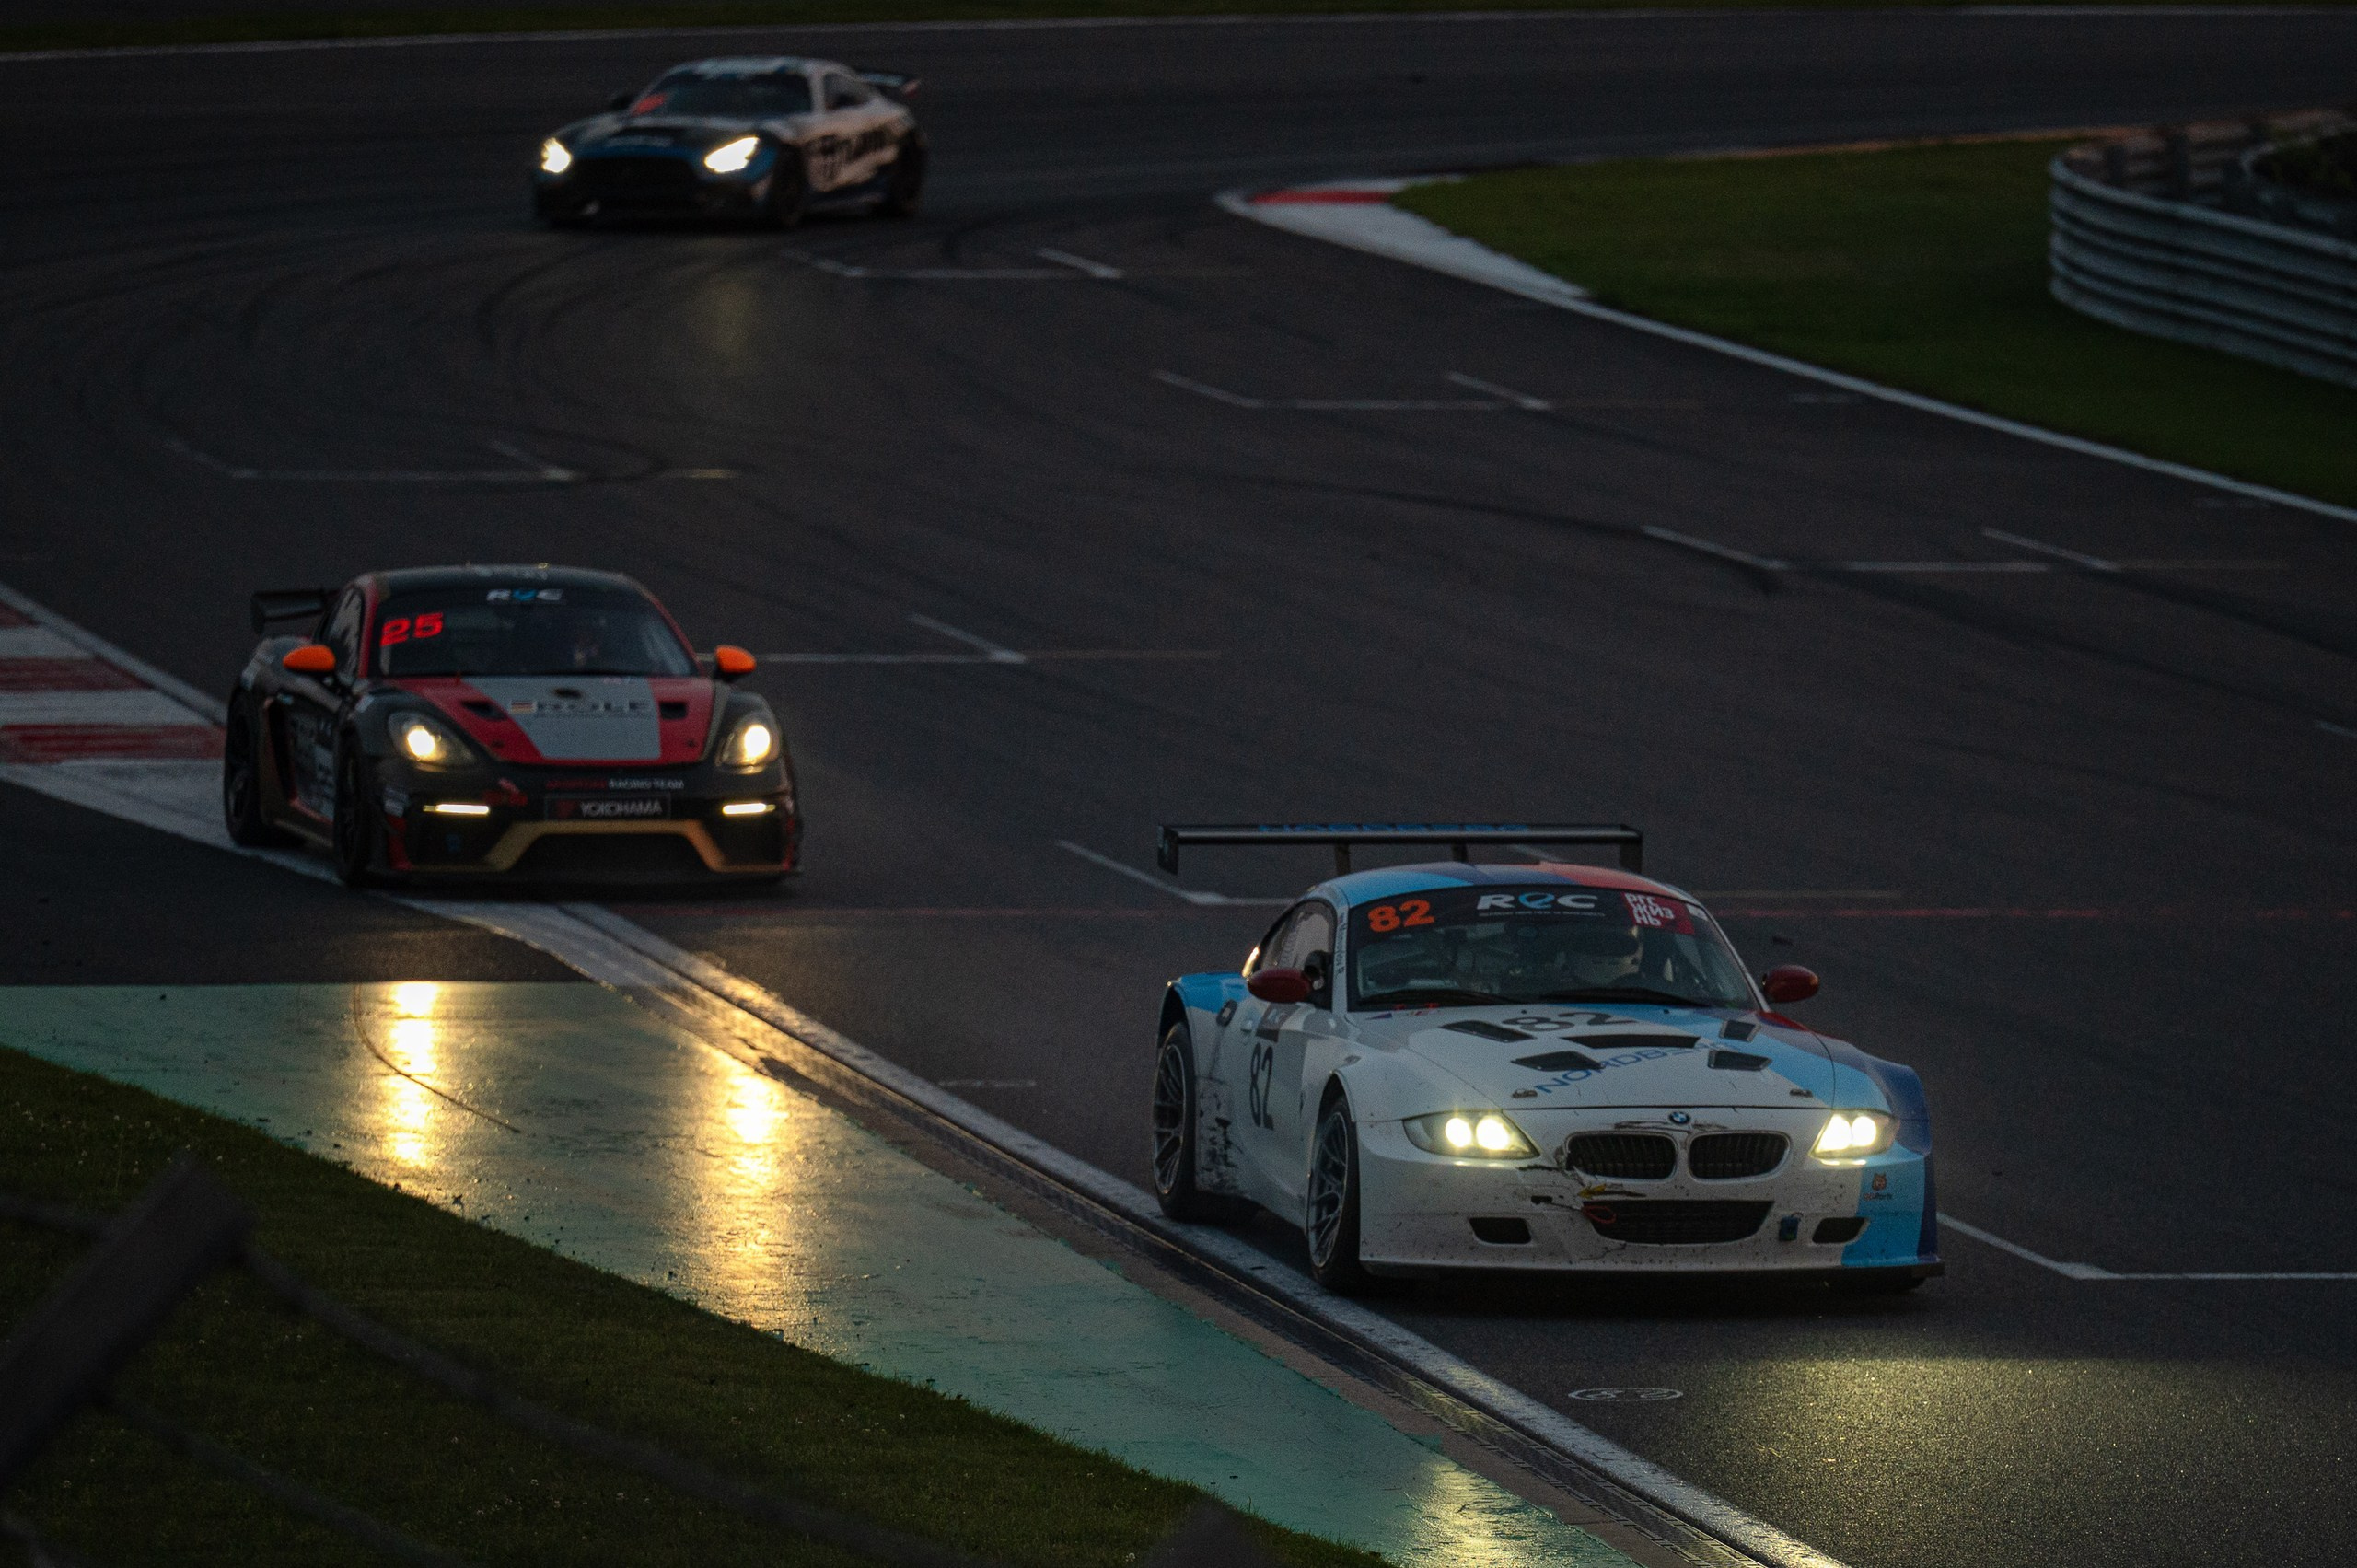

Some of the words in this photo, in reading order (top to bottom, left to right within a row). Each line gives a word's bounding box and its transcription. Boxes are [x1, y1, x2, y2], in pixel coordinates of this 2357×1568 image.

[379, 612, 444, 647] 25
[609, 778, 651, 790] RACING
[653, 778, 685, 790] TEAM
[579, 799, 664, 818] YOKOHAMA
[1367, 899, 1436, 933] 82
[1502, 1012, 1638, 1032] 82
[1250, 1041, 1274, 1132] 82
